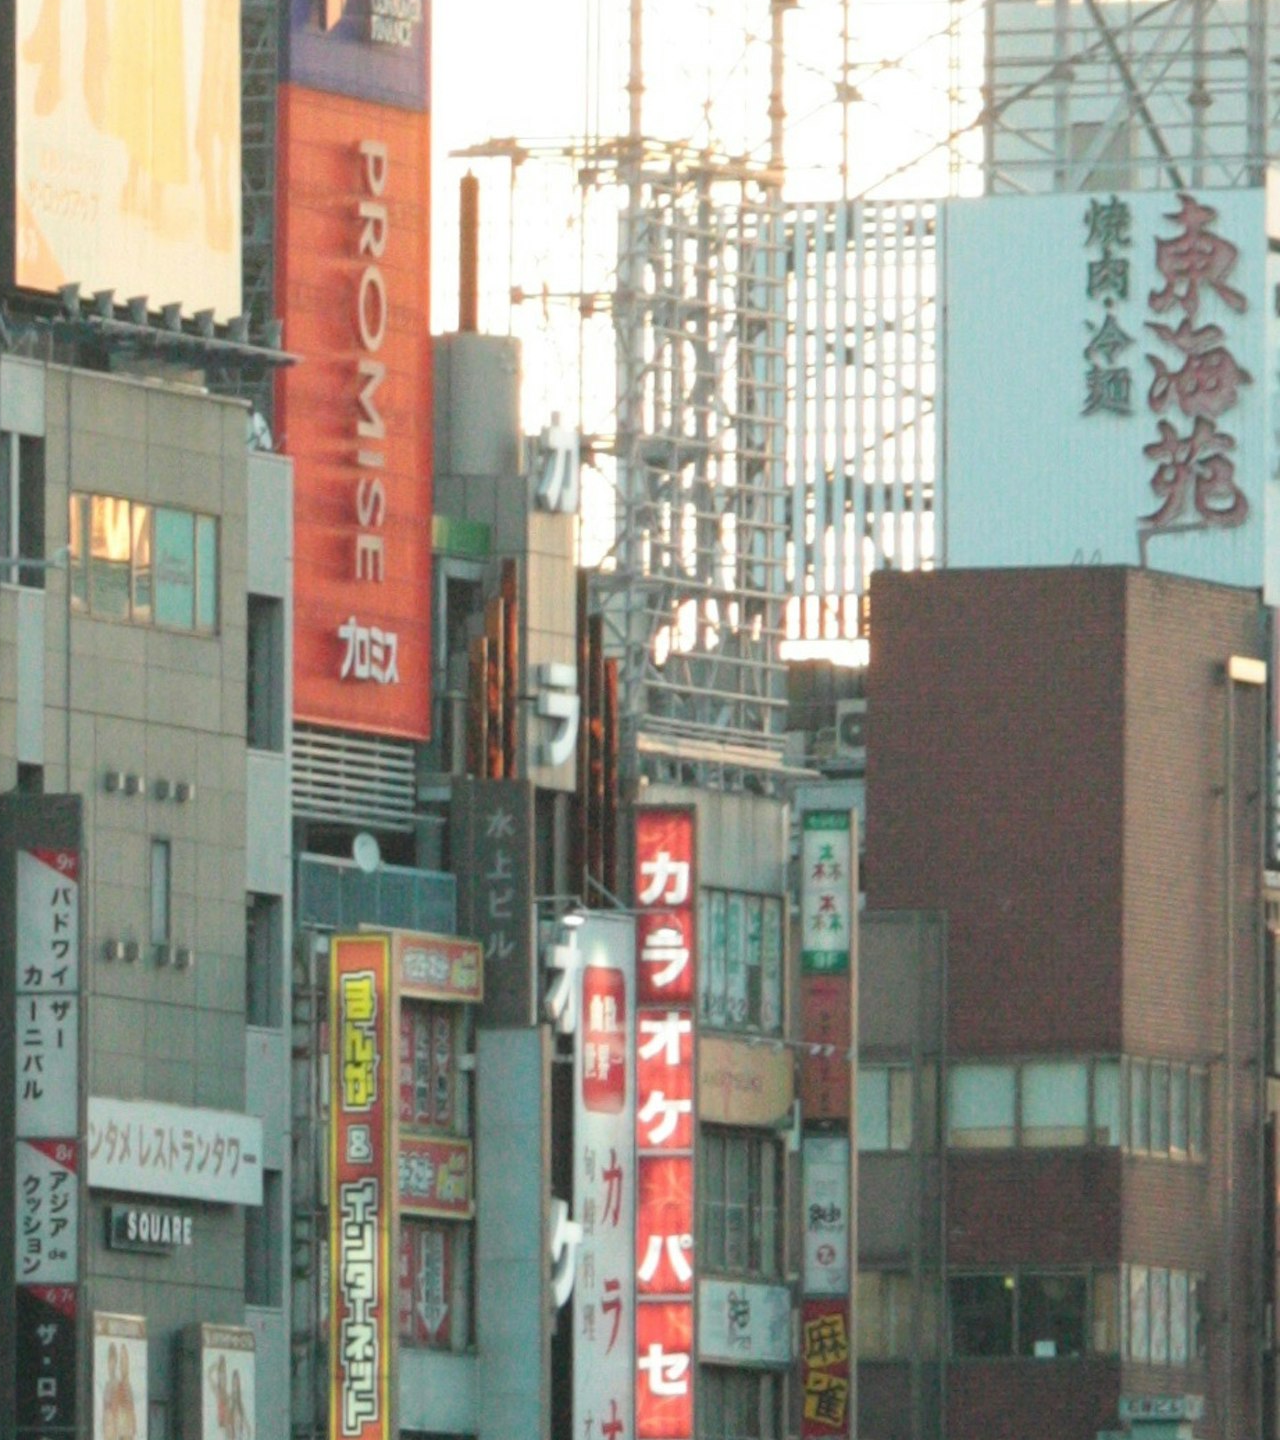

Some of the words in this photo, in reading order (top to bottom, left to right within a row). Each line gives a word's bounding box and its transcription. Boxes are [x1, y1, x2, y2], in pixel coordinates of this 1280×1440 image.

[356, 137, 388, 582] PROMISE
[1138, 193, 1252, 528] 東海苑
[338, 615, 399, 685] プロミス
[22, 965, 44, 1101] カーニバル
[126, 1211, 193, 1247] SQUARE
